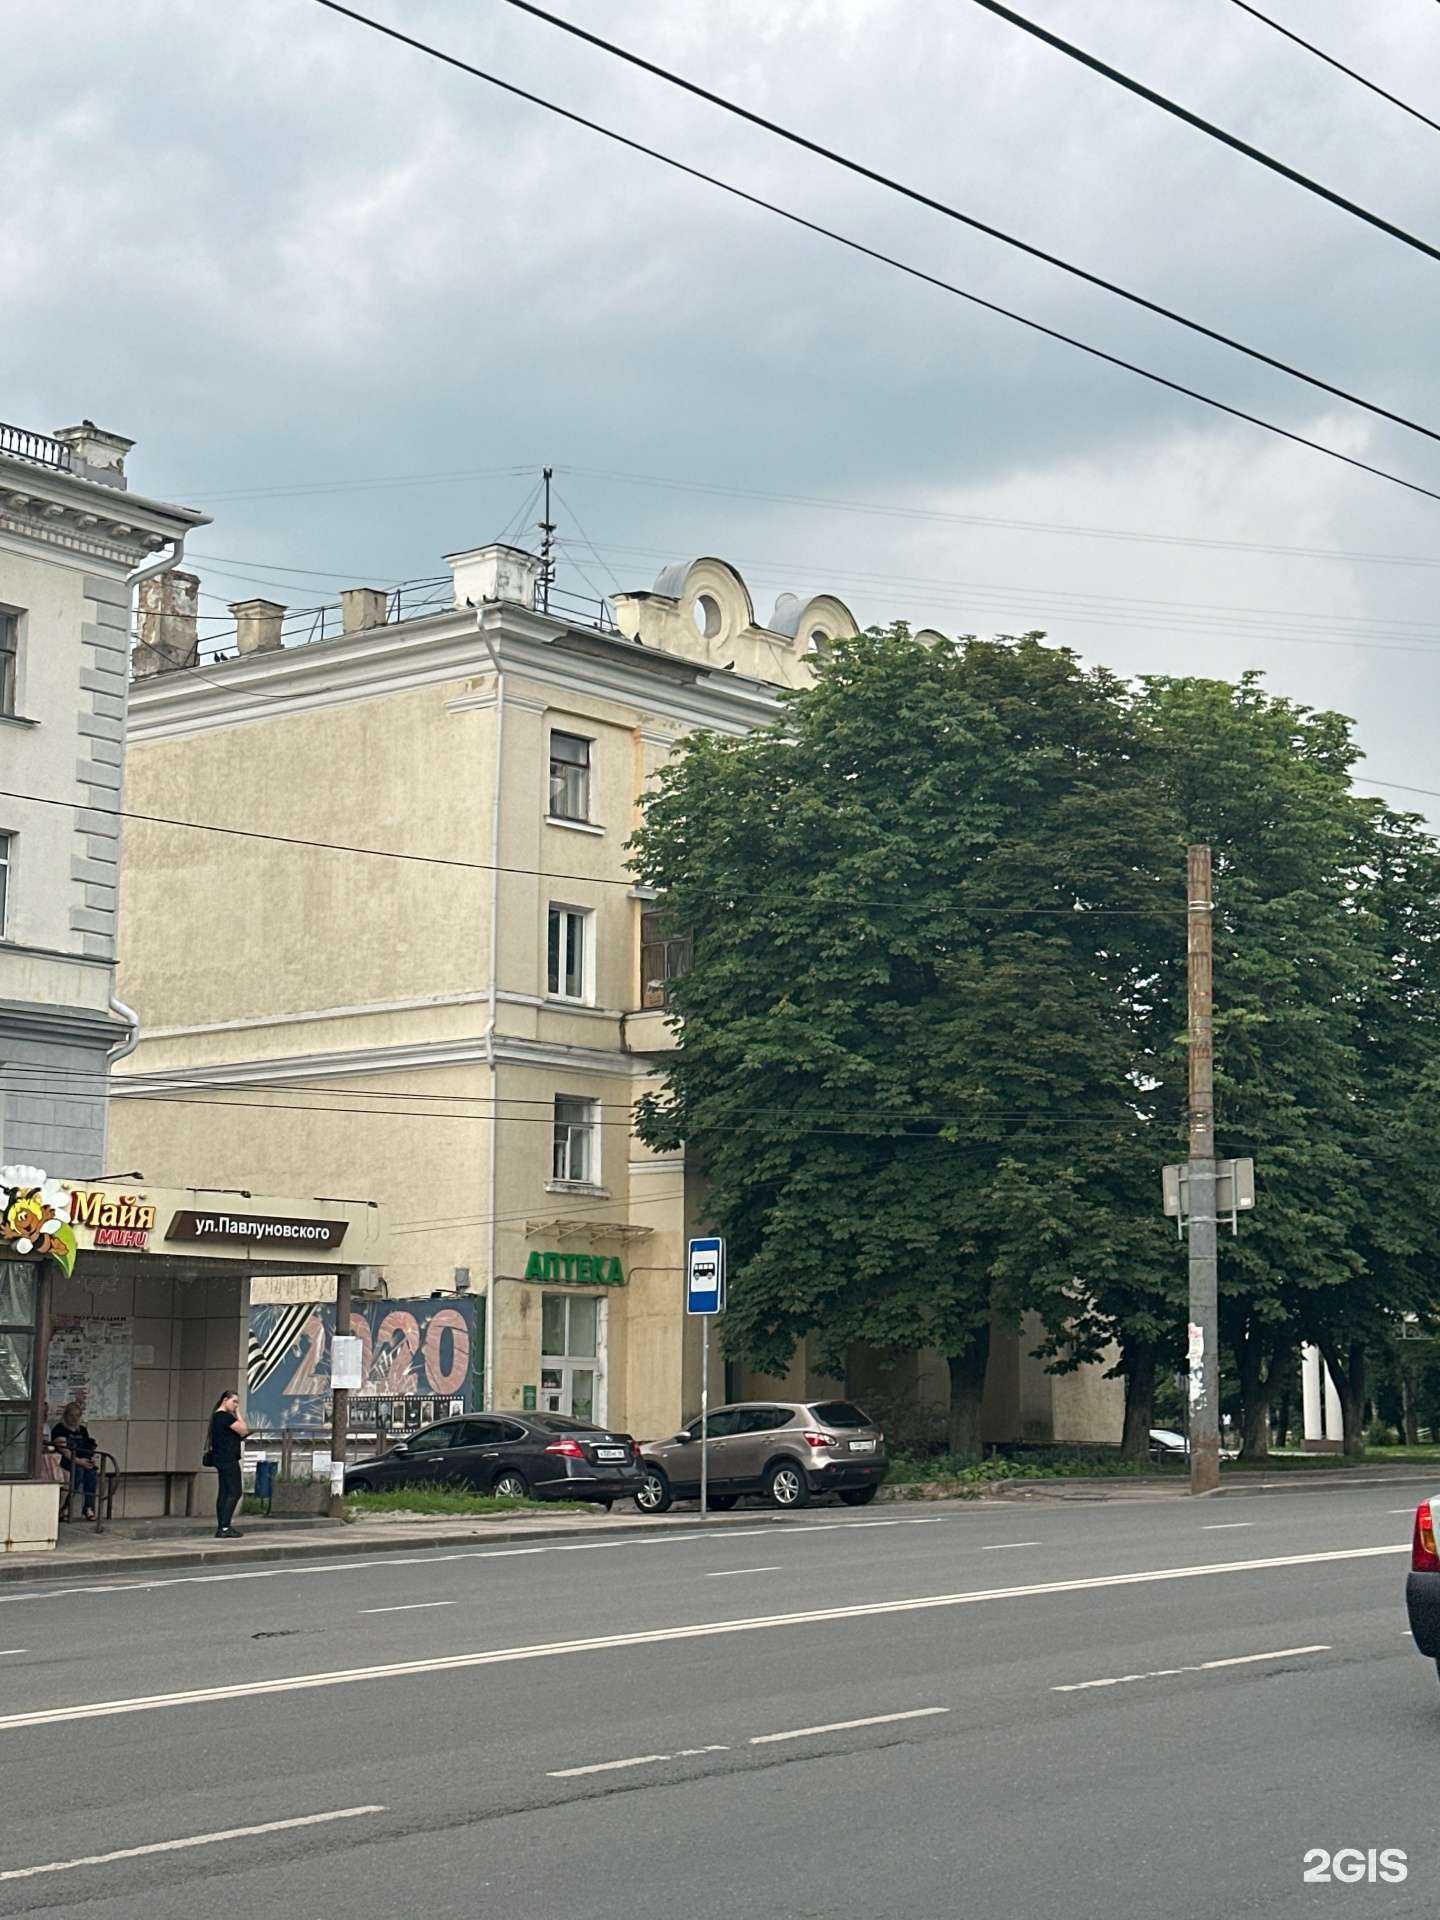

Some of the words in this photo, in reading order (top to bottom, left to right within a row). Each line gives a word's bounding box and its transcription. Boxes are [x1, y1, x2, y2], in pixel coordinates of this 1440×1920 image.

[71, 1191, 156, 1229] Майя
[195, 1216, 331, 1240] ул.Павлуновского
[525, 1251, 625, 1284] АПТЕКА
